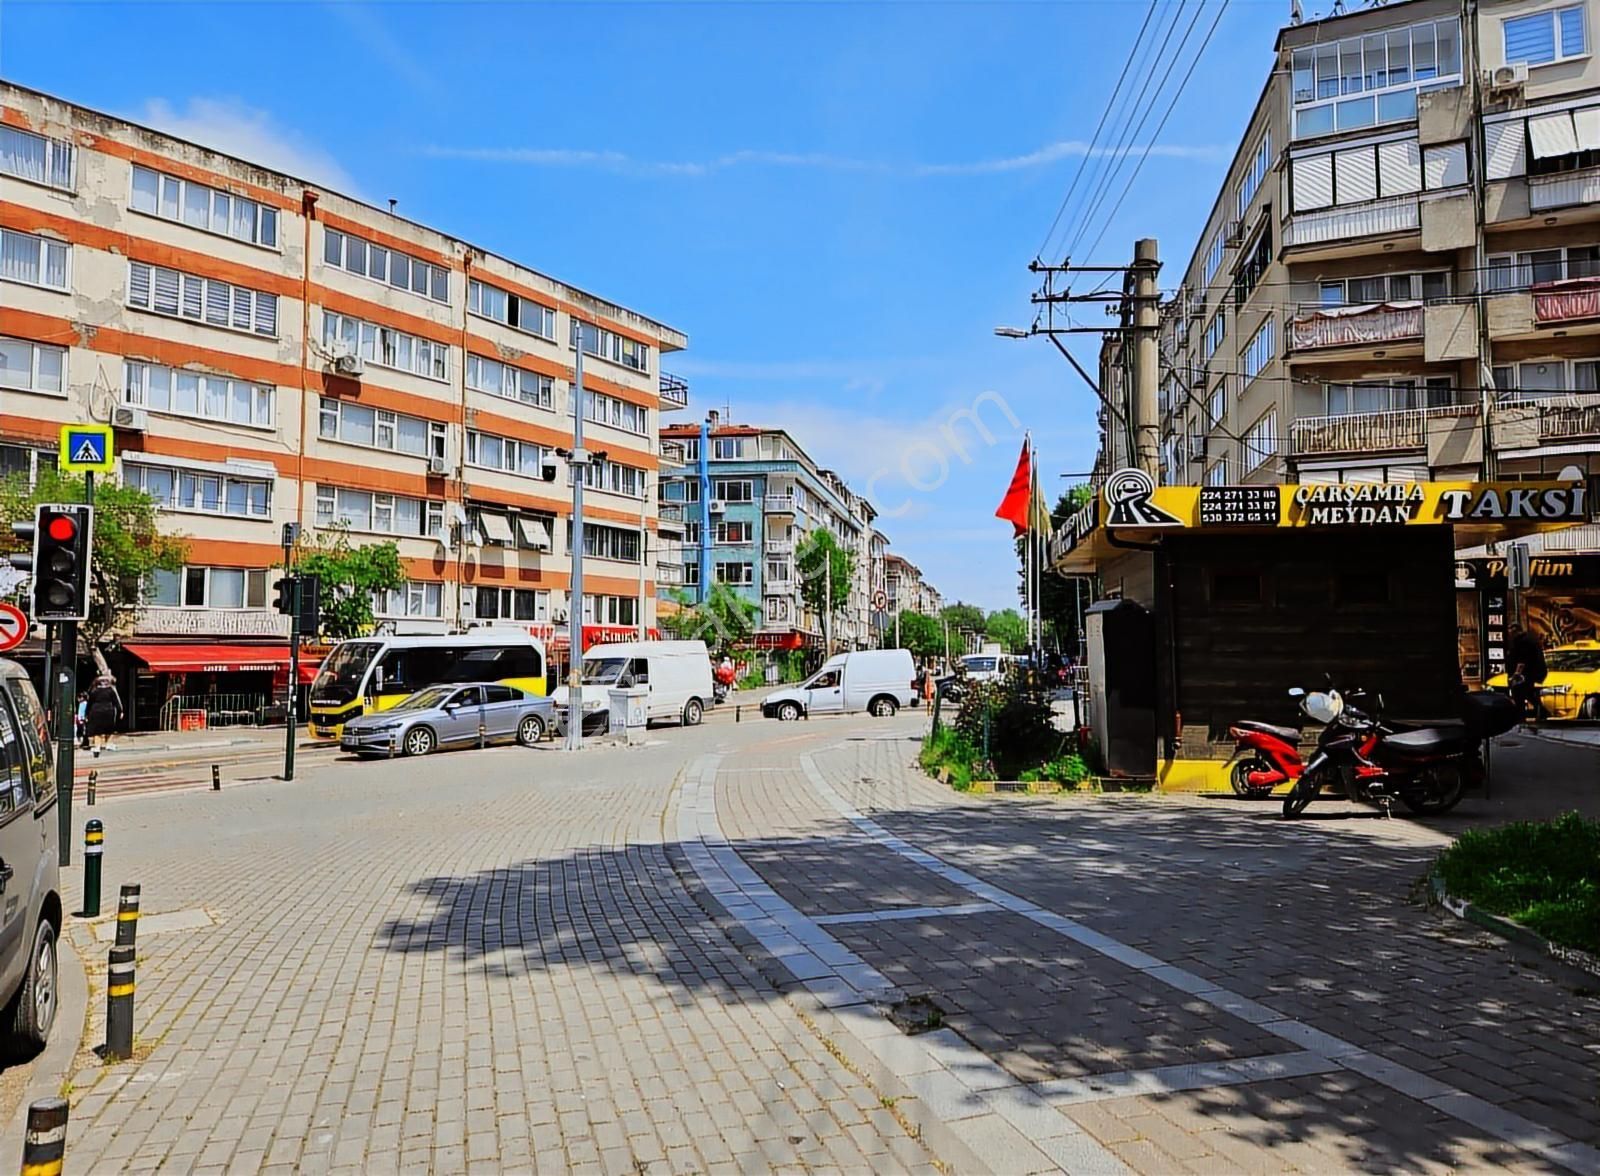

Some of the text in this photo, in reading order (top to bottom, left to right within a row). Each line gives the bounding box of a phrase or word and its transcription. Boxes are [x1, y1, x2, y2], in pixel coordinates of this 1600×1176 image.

[1202, 491, 1221, 500] 224
[1224, 491, 1243, 499] 271
[1296, 484, 1425, 507] ÇARŞAMBA
[1443, 482, 1587, 518] TAKSİ
[1202, 502, 1222, 511] 224
[1224, 502, 1243, 510] 271
[1310, 505, 1412, 525] MEYDAN
[1486, 559, 1574, 578] Pfüm
